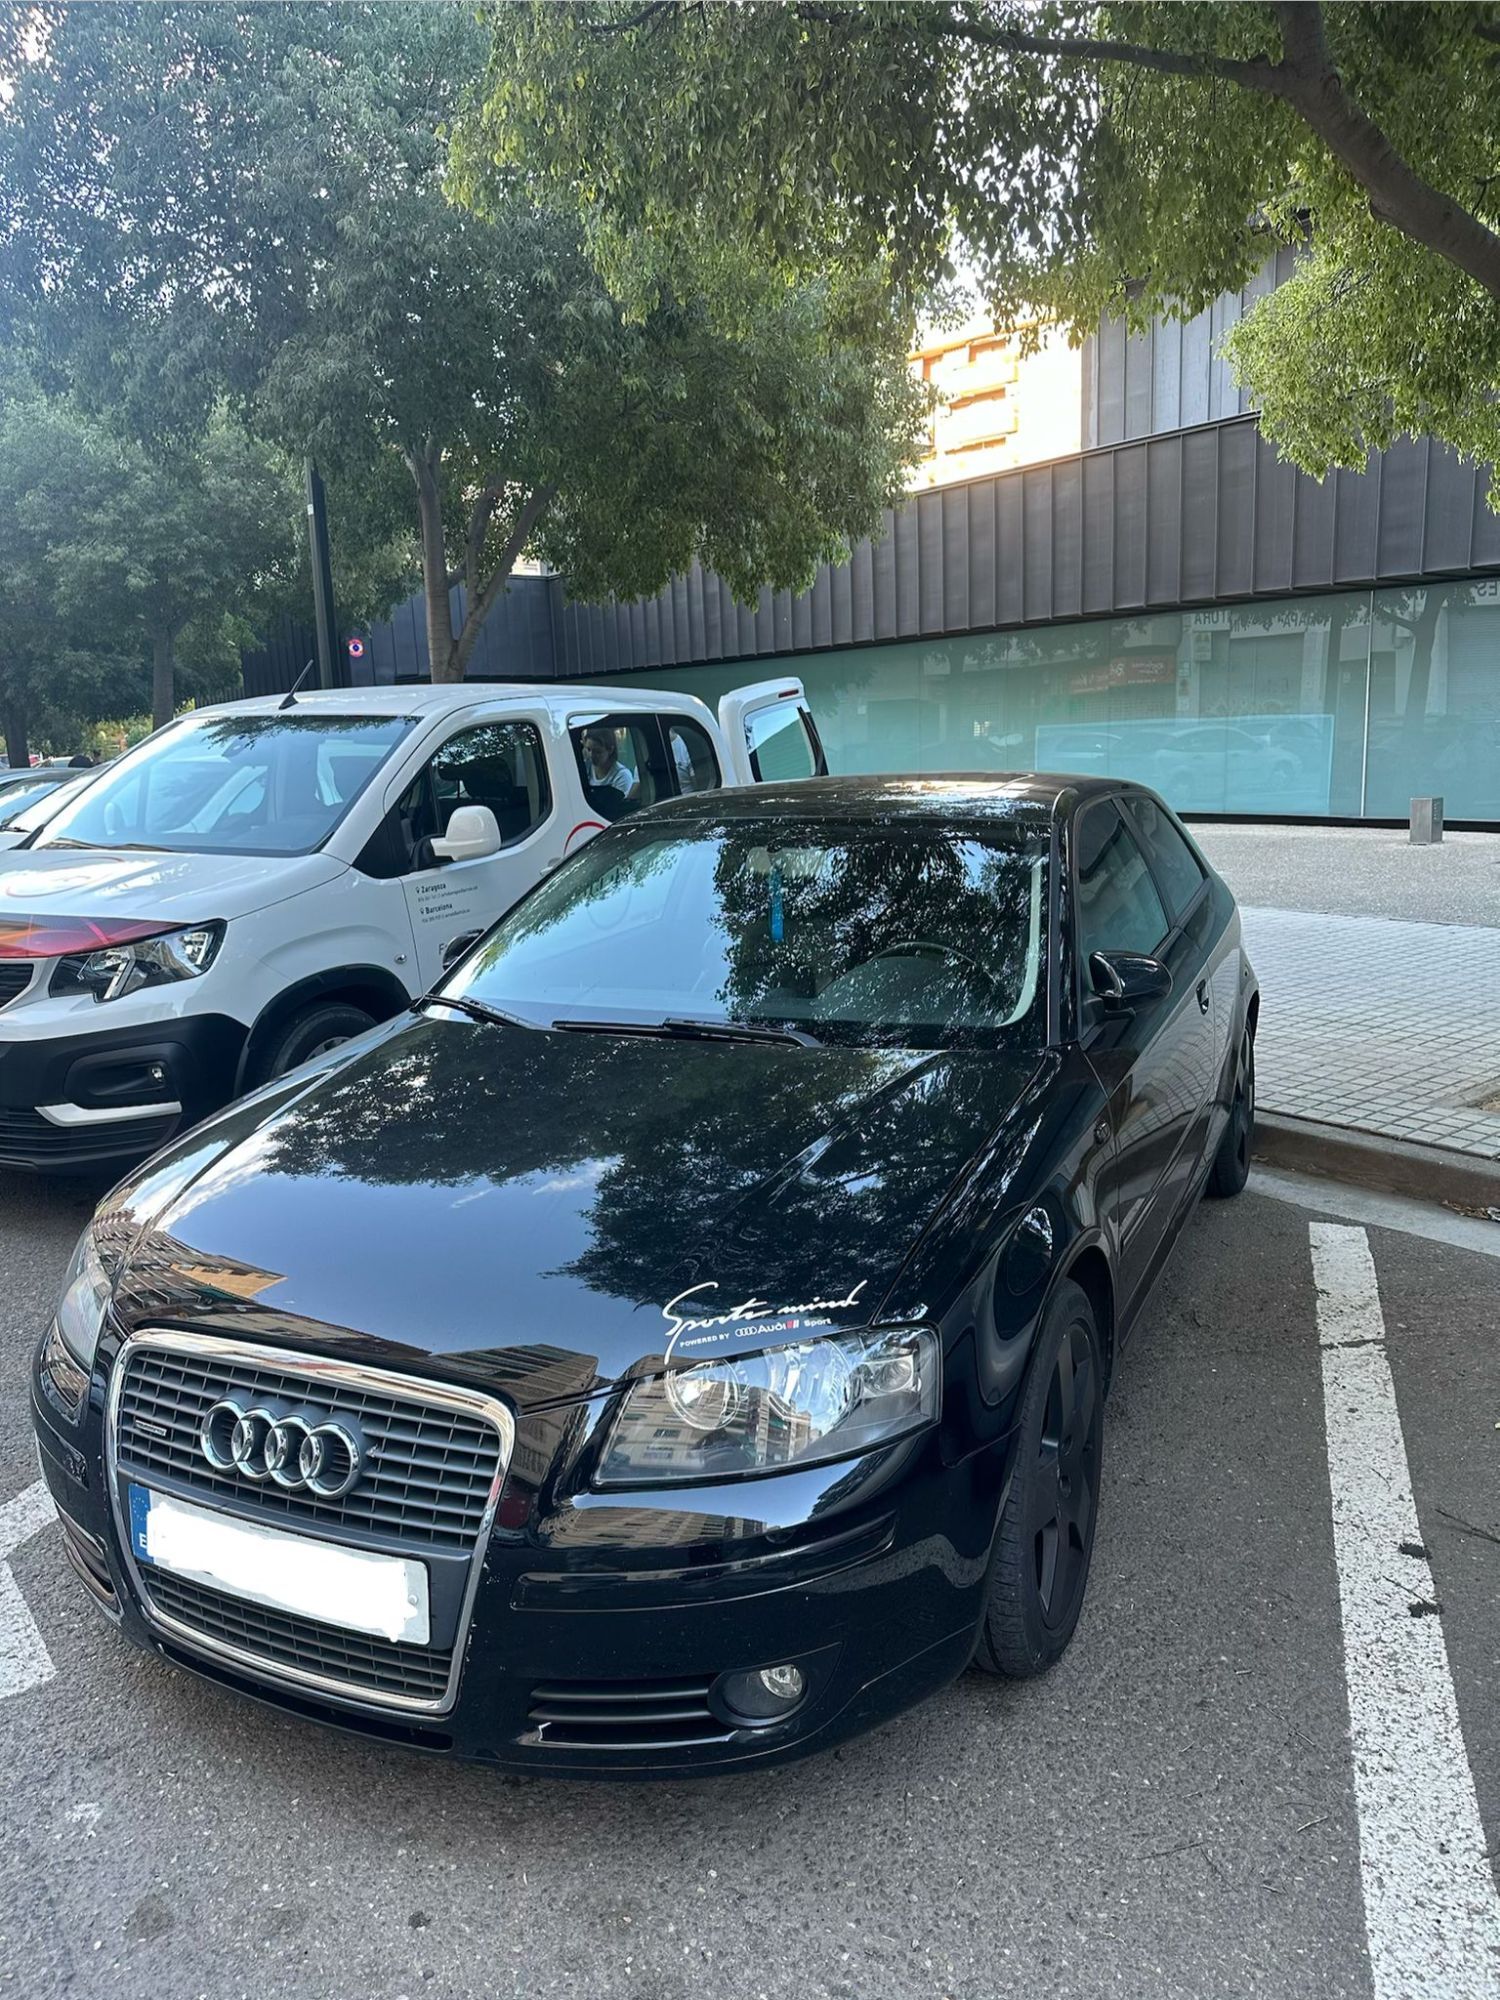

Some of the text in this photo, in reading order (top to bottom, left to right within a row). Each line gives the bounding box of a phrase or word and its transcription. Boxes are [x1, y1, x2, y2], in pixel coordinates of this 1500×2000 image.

[421, 883, 446, 894] Zaragoza
[425, 903, 453, 914] Barcelona
[777, 1279, 868, 1314] mind
[680, 1318, 832, 1348] POWERED BY Audi Sport
[139, 1533, 147, 1547] E
